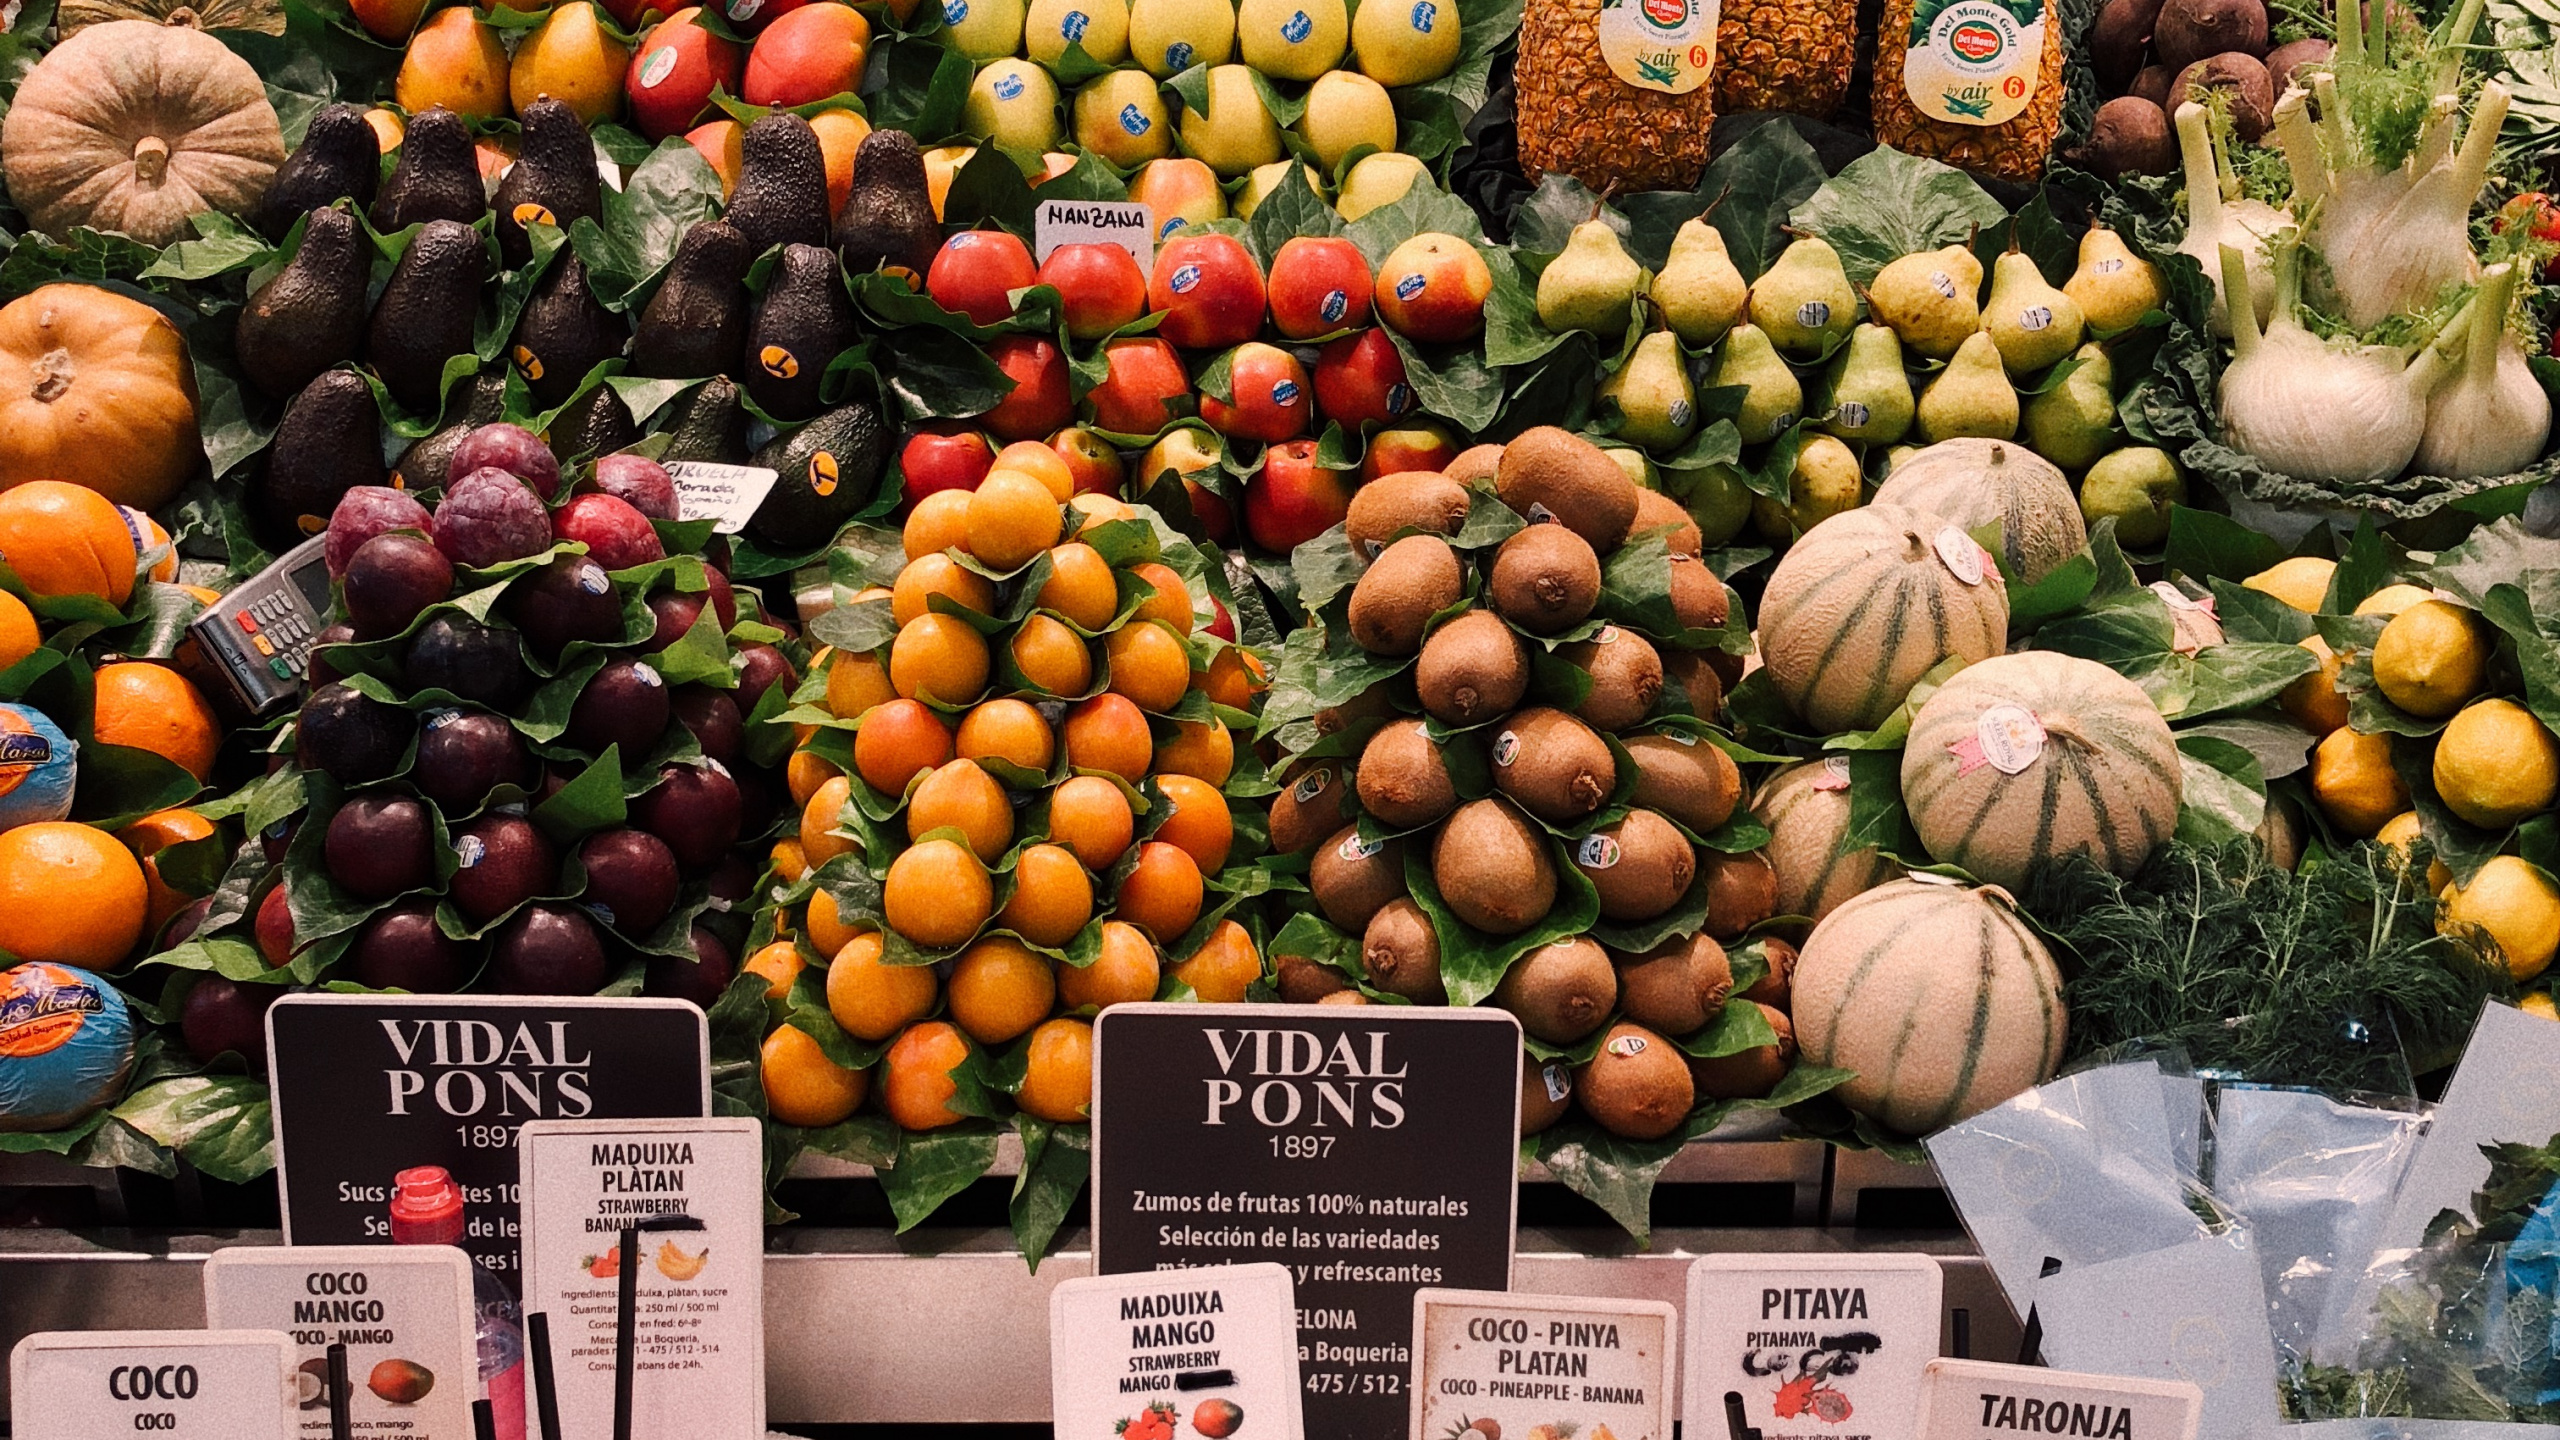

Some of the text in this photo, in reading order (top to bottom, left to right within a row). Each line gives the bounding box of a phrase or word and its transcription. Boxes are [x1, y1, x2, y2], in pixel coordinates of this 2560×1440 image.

[1938, 7, 2017, 47] Del Monte Gold
[1958, 34, 1996, 48] Del Monte
[1640, 48, 1681, 66] by air
[1947, 82, 1994, 100] by air
[1048, 205, 1145, 228] MANZANA
[665, 463, 748, 479] CIRUELA
[378, 1019, 592, 1067] VIDAL
[1202, 1028, 1408, 1078] VIDAL
[383, 1069, 593, 1117] PONS
[1202, 1078, 1405, 1129] PONS
[456, 1125, 519, 1148] 1897
[1269, 1135, 1336, 1159] 1897
[592, 1143, 694, 1166] MADUIXA
[602, 1165, 684, 1192] PLÀTAN
[338, 1181, 385, 1202] Sucs
[598, 1198, 689, 1214] STRAWBERRY
[1133, 1190, 1469, 1217] Zumos de frutas 100% naturales
[468, 1216, 521, 1237] de le
[1159, 1224, 1440, 1250] Selección de las variedades
[306, 1272, 367, 1295] COCO
[1297, 1265, 1309, 1285] y
[1314, 1260, 1442, 1282] refrescantes
[561, 1288, 728, 1301] Ingredients: duixa, plàtan, sucre
[1120, 1290, 1224, 1320] MADUIXA
[1761, 1288, 1868, 1320] PITAYA
[294, 1300, 384, 1323] MANGO
[570, 1305, 617, 1315] Quantitat
[645, 1304, 663, 1313] 250
[666, 1304, 678, 1312] ml
[687, 1303, 704, 1312] 500
[707, 1302, 719, 1311] ml
[1296, 1309, 1357, 1329] ELONA
[589, 1320, 637, 1329] Conser
[654, 1318, 676, 1328] fred:
[1132, 1320, 1215, 1349] MANGO
[1468, 1317, 1528, 1344] COCO
[1549, 1321, 1620, 1349] PINYA
[338, 1329, 393, 1344] MANGO
[591, 1334, 700, 1345] Merca La Boqueria,
[1746, 1331, 1816, 1348] PITAHAYA
[571, 1347, 609, 1358] parades
[649, 1346, 667, 1354] 475
[676, 1345, 693, 1354] 512
[702, 1345, 720, 1353] 514
[1129, 1350, 1221, 1373] STRAWBERRY
[1316, 1341, 1409, 1366] Boqueria
[588, 1360, 703, 1371] Consu abans de 24h.
[1498, 1349, 1588, 1378] PLATAN
[109, 1365, 199, 1400] COCO
[1119, 1374, 1170, 1394] MANGO
[1306, 1374, 1344, 1393] 475
[1348, 1374, 1358, 1394] /
[1362, 1375, 1399, 1394] 512
[1440, 1378, 1477, 1396] COCO
[1489, 1380, 1570, 1401] PINEAPPLE
[1582, 1385, 1645, 1406] BANANA
[134, 1413, 176, 1430] COCO
[351, 1421, 414, 1431] oco, mango
[1980, 1393, 2132, 1440] TARONJA
